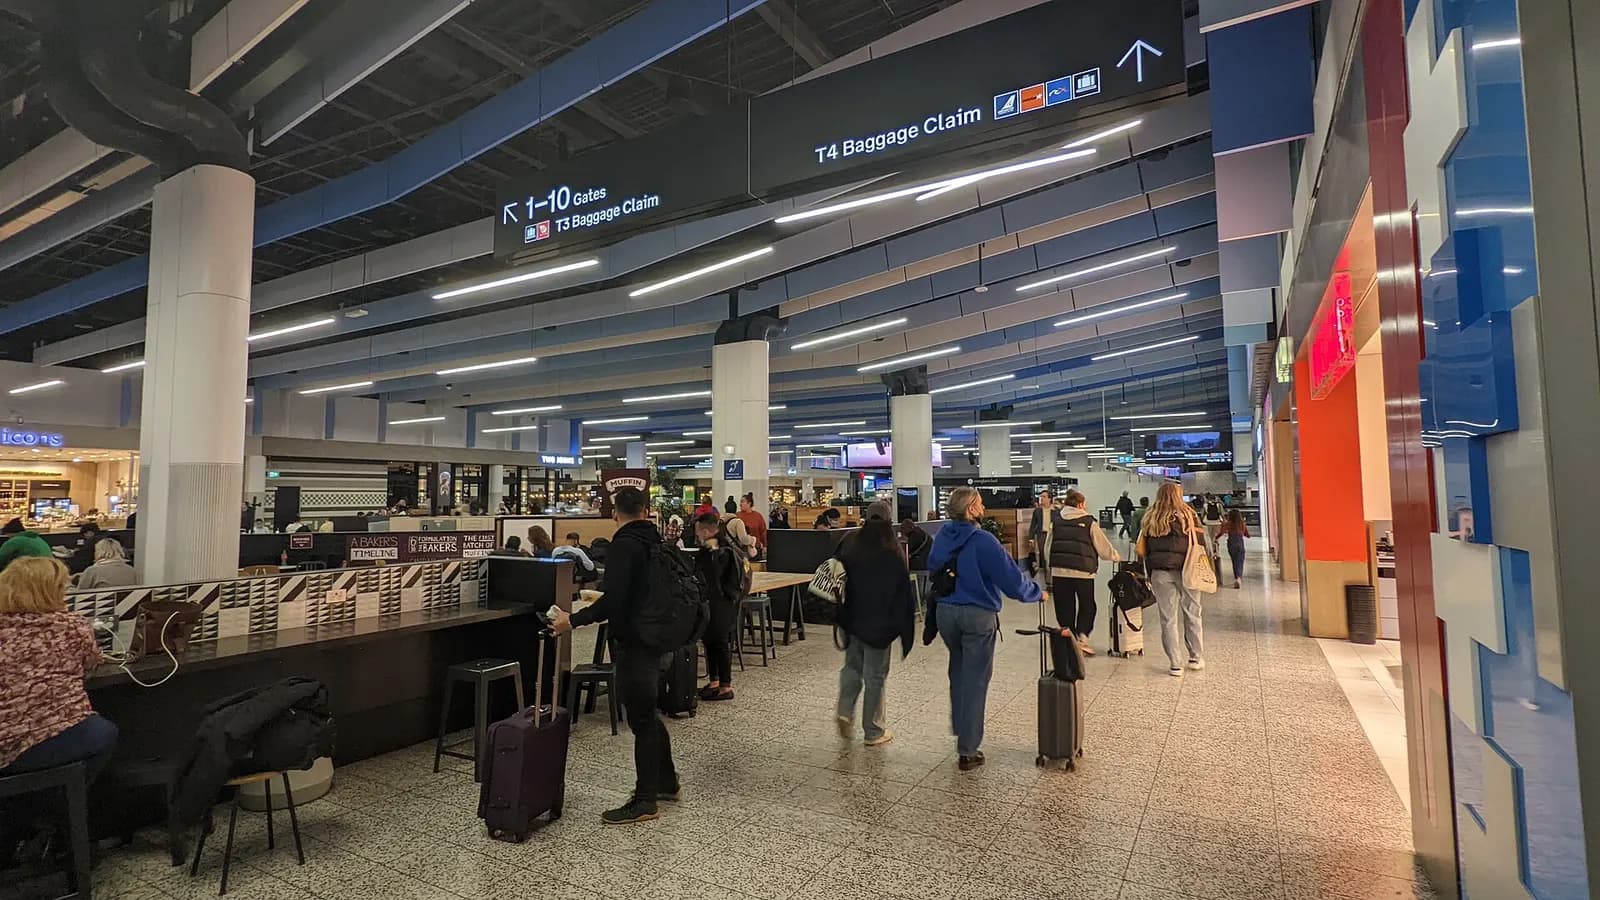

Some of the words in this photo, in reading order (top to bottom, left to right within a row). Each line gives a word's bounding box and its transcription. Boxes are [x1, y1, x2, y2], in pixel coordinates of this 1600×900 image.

[815, 144, 839, 163] T4
[843, 125, 919, 156] Baggage
[923, 107, 981, 134] Claim
[573, 187, 607, 206] Gates
[555, 217, 571, 232] T3
[572, 205, 620, 228] Baggage
[622, 194, 659, 214] Claim
[610, 479, 642, 487] MUFFIN
[351, 537, 359, 547] A
[422, 543, 458, 552] BAKERS
[353, 550, 396, 558] TIMELINE
